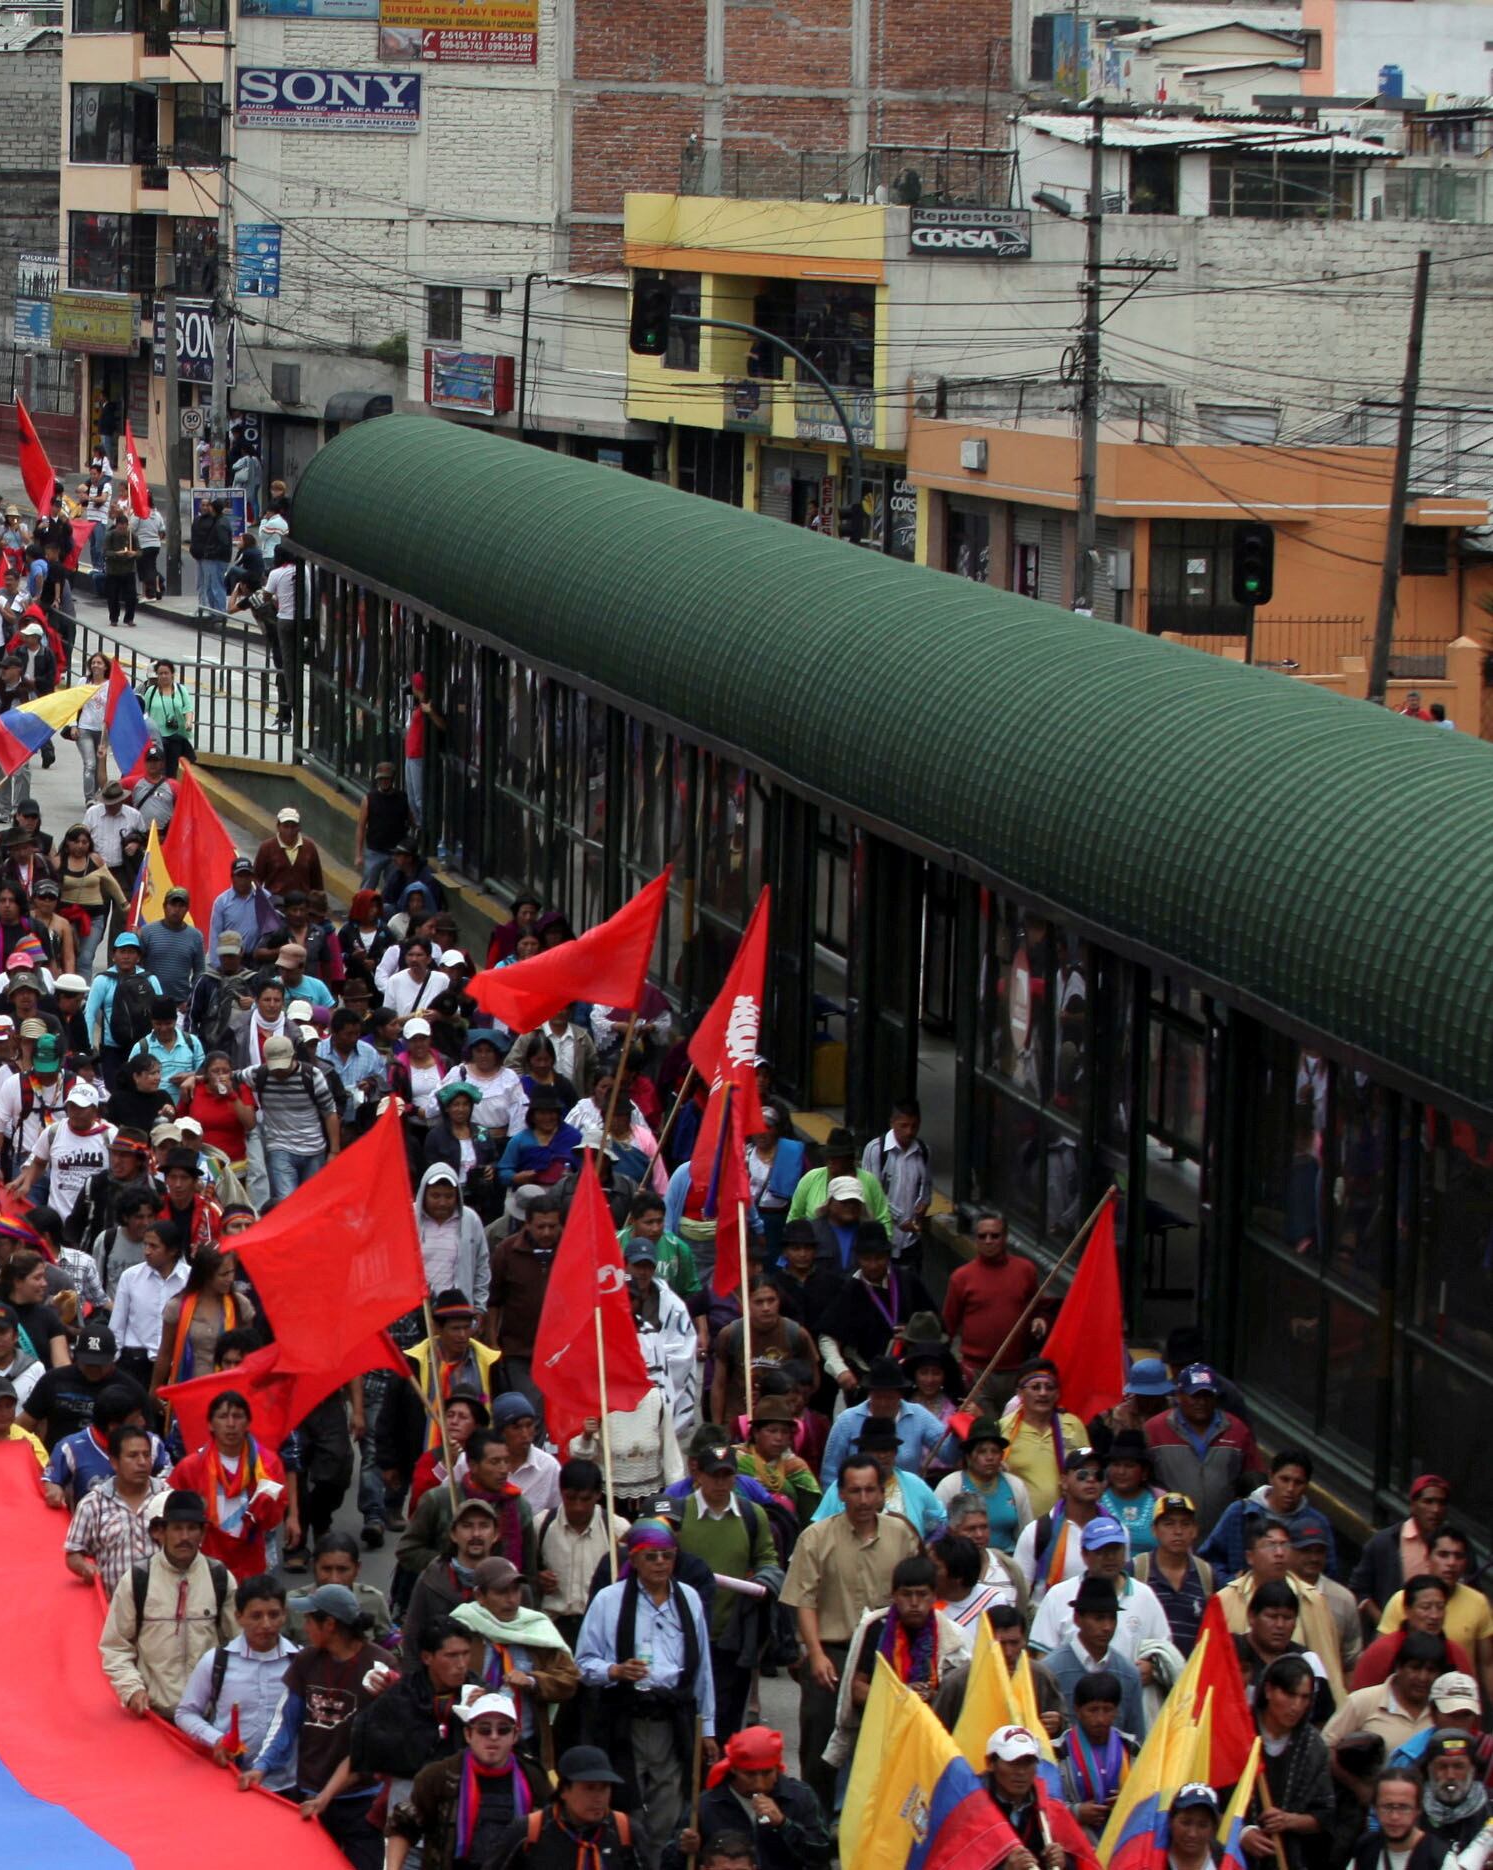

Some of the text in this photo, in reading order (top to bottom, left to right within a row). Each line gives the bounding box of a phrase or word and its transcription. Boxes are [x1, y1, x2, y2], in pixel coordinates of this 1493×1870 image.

[384, 5, 533, 17] SISTEMA DE AGUA Y ESPUMA
[240, 70, 416, 107] SONY
[249, 115, 296, 123] SERVICIO
[345, 119, 416, 127] GARANTIZADO
[913, 209, 1013, 223] Repuestos
[911, 228, 999, 249] CORSA
[186, 414, 198, 423] 50
